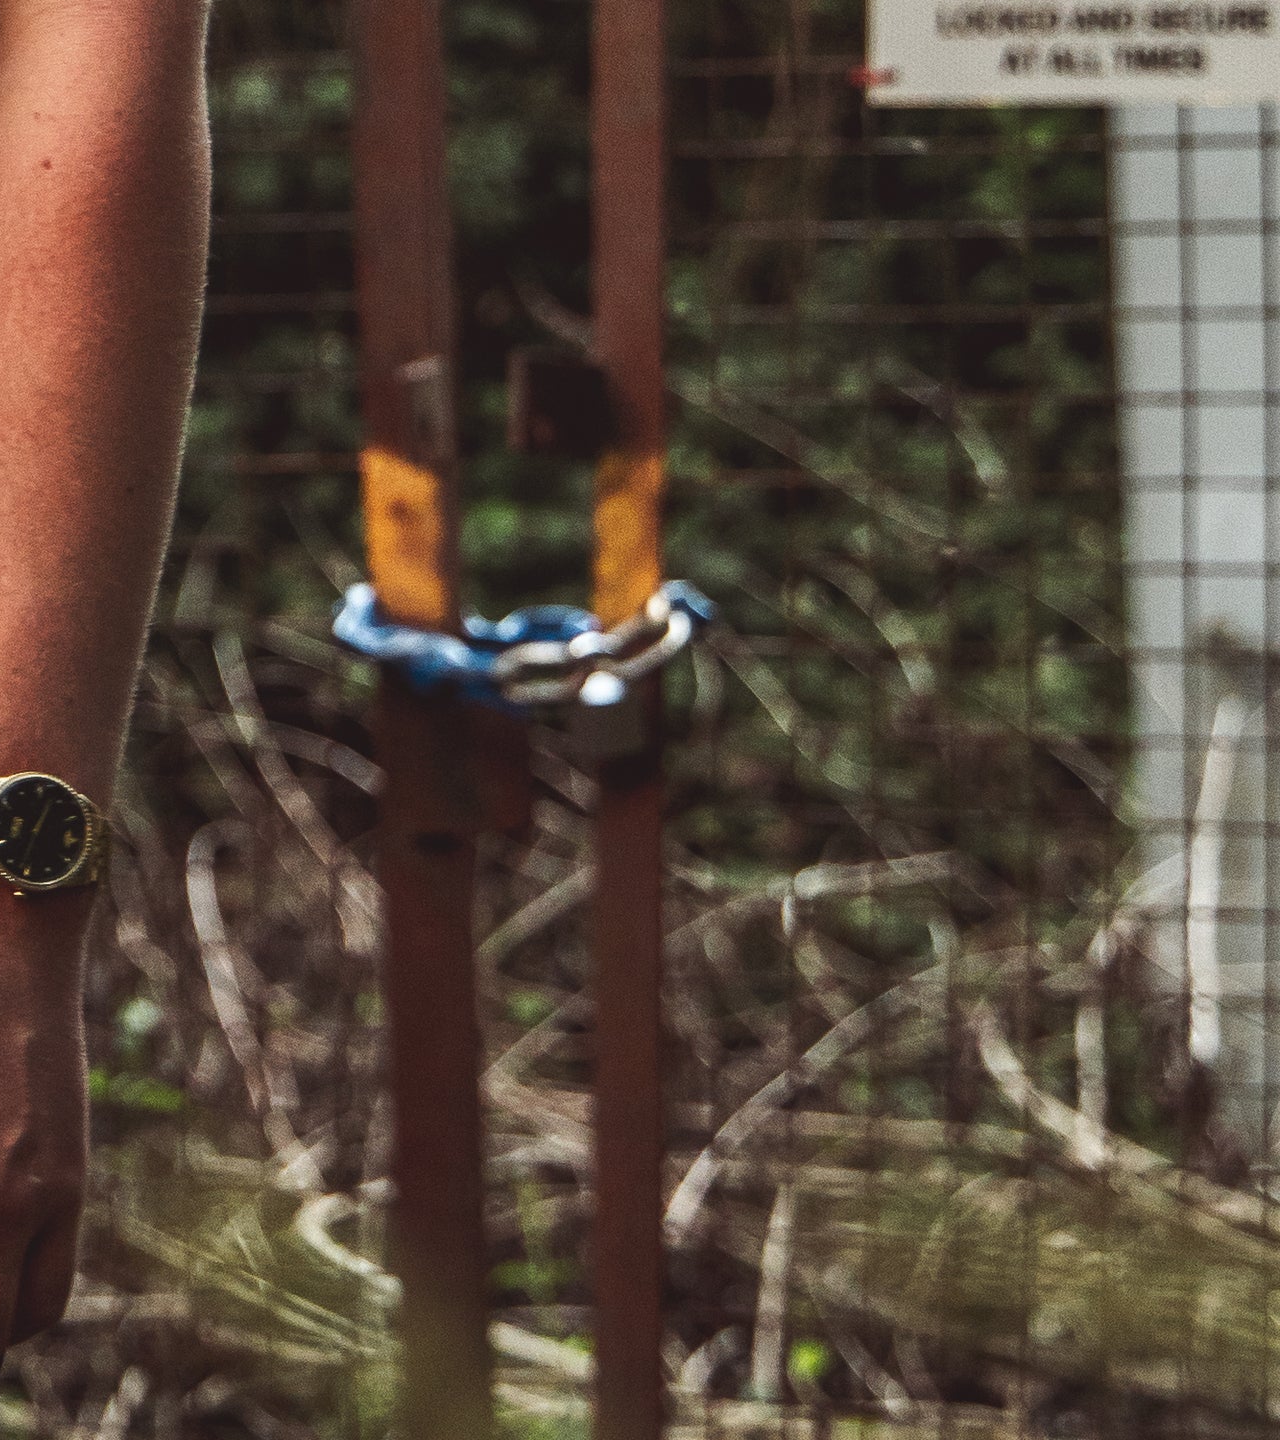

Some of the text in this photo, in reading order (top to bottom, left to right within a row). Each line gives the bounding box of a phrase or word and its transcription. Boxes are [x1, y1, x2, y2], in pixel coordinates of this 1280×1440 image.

[936, 1, 1270, 37] LOCKED AND SECURE
[1000, 42, 1206, 76] AT ALL TIMES
